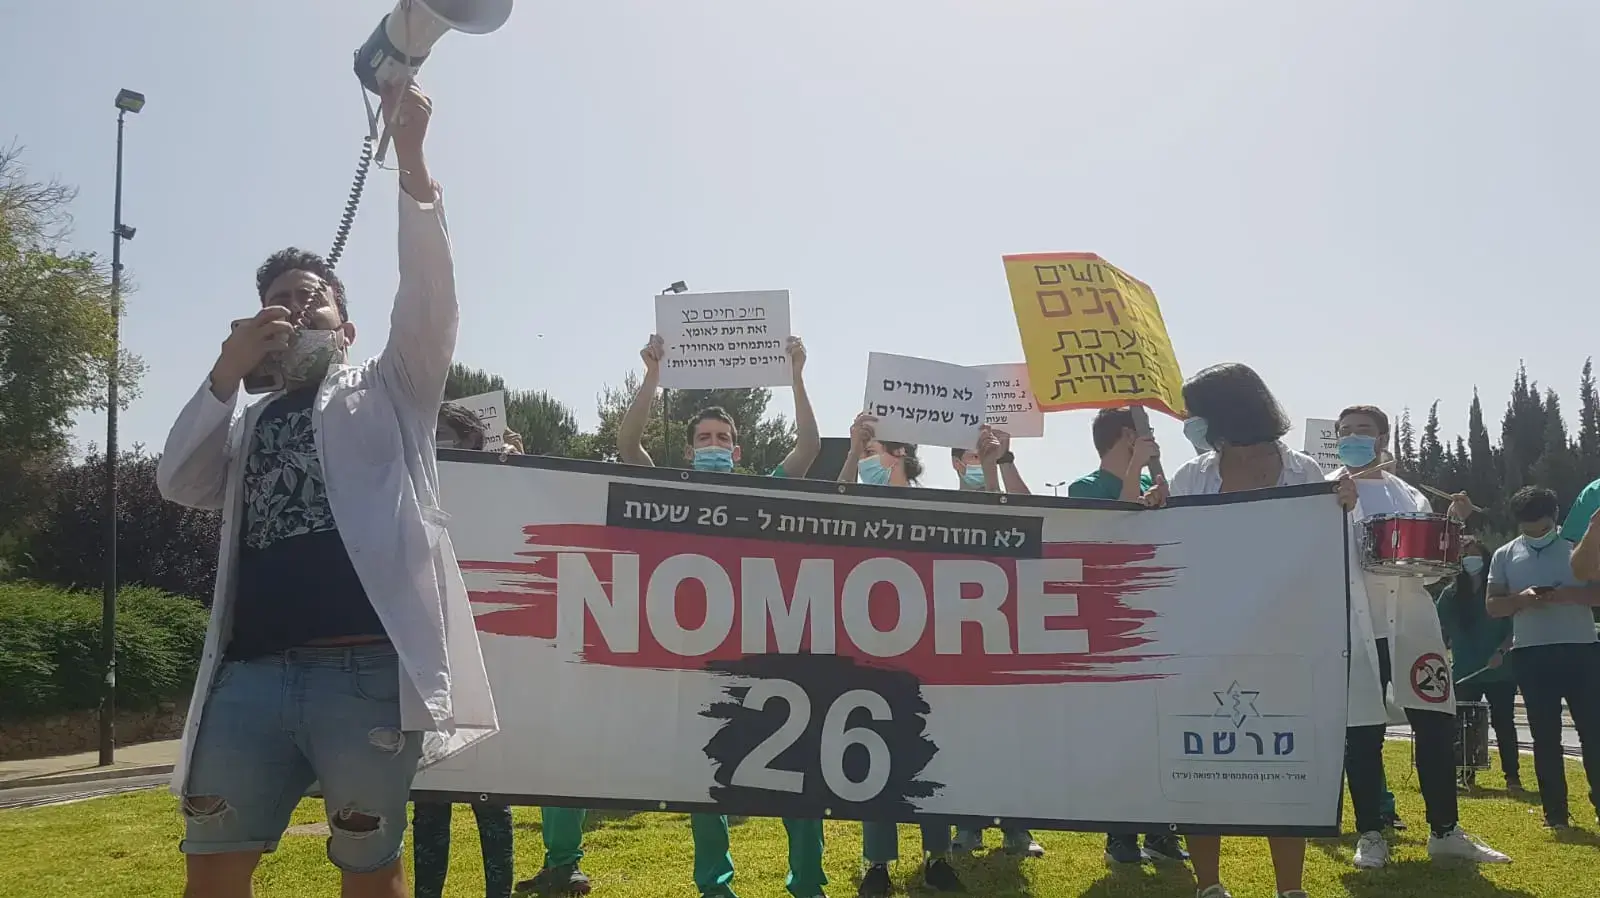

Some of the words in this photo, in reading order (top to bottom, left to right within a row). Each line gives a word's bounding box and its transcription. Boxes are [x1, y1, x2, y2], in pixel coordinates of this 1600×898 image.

[681, 310, 699, 322] כץ
[703, 308, 735, 319] חיים
[682, 326, 718, 338] לאומץ.
[721, 326, 744, 335] העת
[747, 325, 767, 334] זאת
[680, 342, 725, 354] מאחוריך
[727, 340, 780, 351] המתמחים
[667, 358, 716, 368] תורנויות!
[718, 356, 746, 368] לקצר
[749, 355, 786, 365] חייבים
[883, 378, 948, 399] מוותרים
[952, 387, 973, 401] לא
[867, 401, 954, 424] שמקצרים!
[959, 412, 979, 426] עד
[623, 499, 690, 523] שעות
[697, 505, 728, 527] 26
[758, 508, 772, 530] ל
[777, 513, 857, 537] חוזרות
[863, 519, 904, 540] ולא
[910, 524, 987, 546] חוזרים
[993, 527, 1026, 548] לא
[556, 552, 1090, 657] NOMORE
[730, 677, 893, 801] 26
[1183, 731, 1294, 755] מרשם
[1193, 771, 1220, 780] לרפואה
[1222, 772, 1259, 780] המתמחים
[1261, 773, 1280, 782] ארגון
